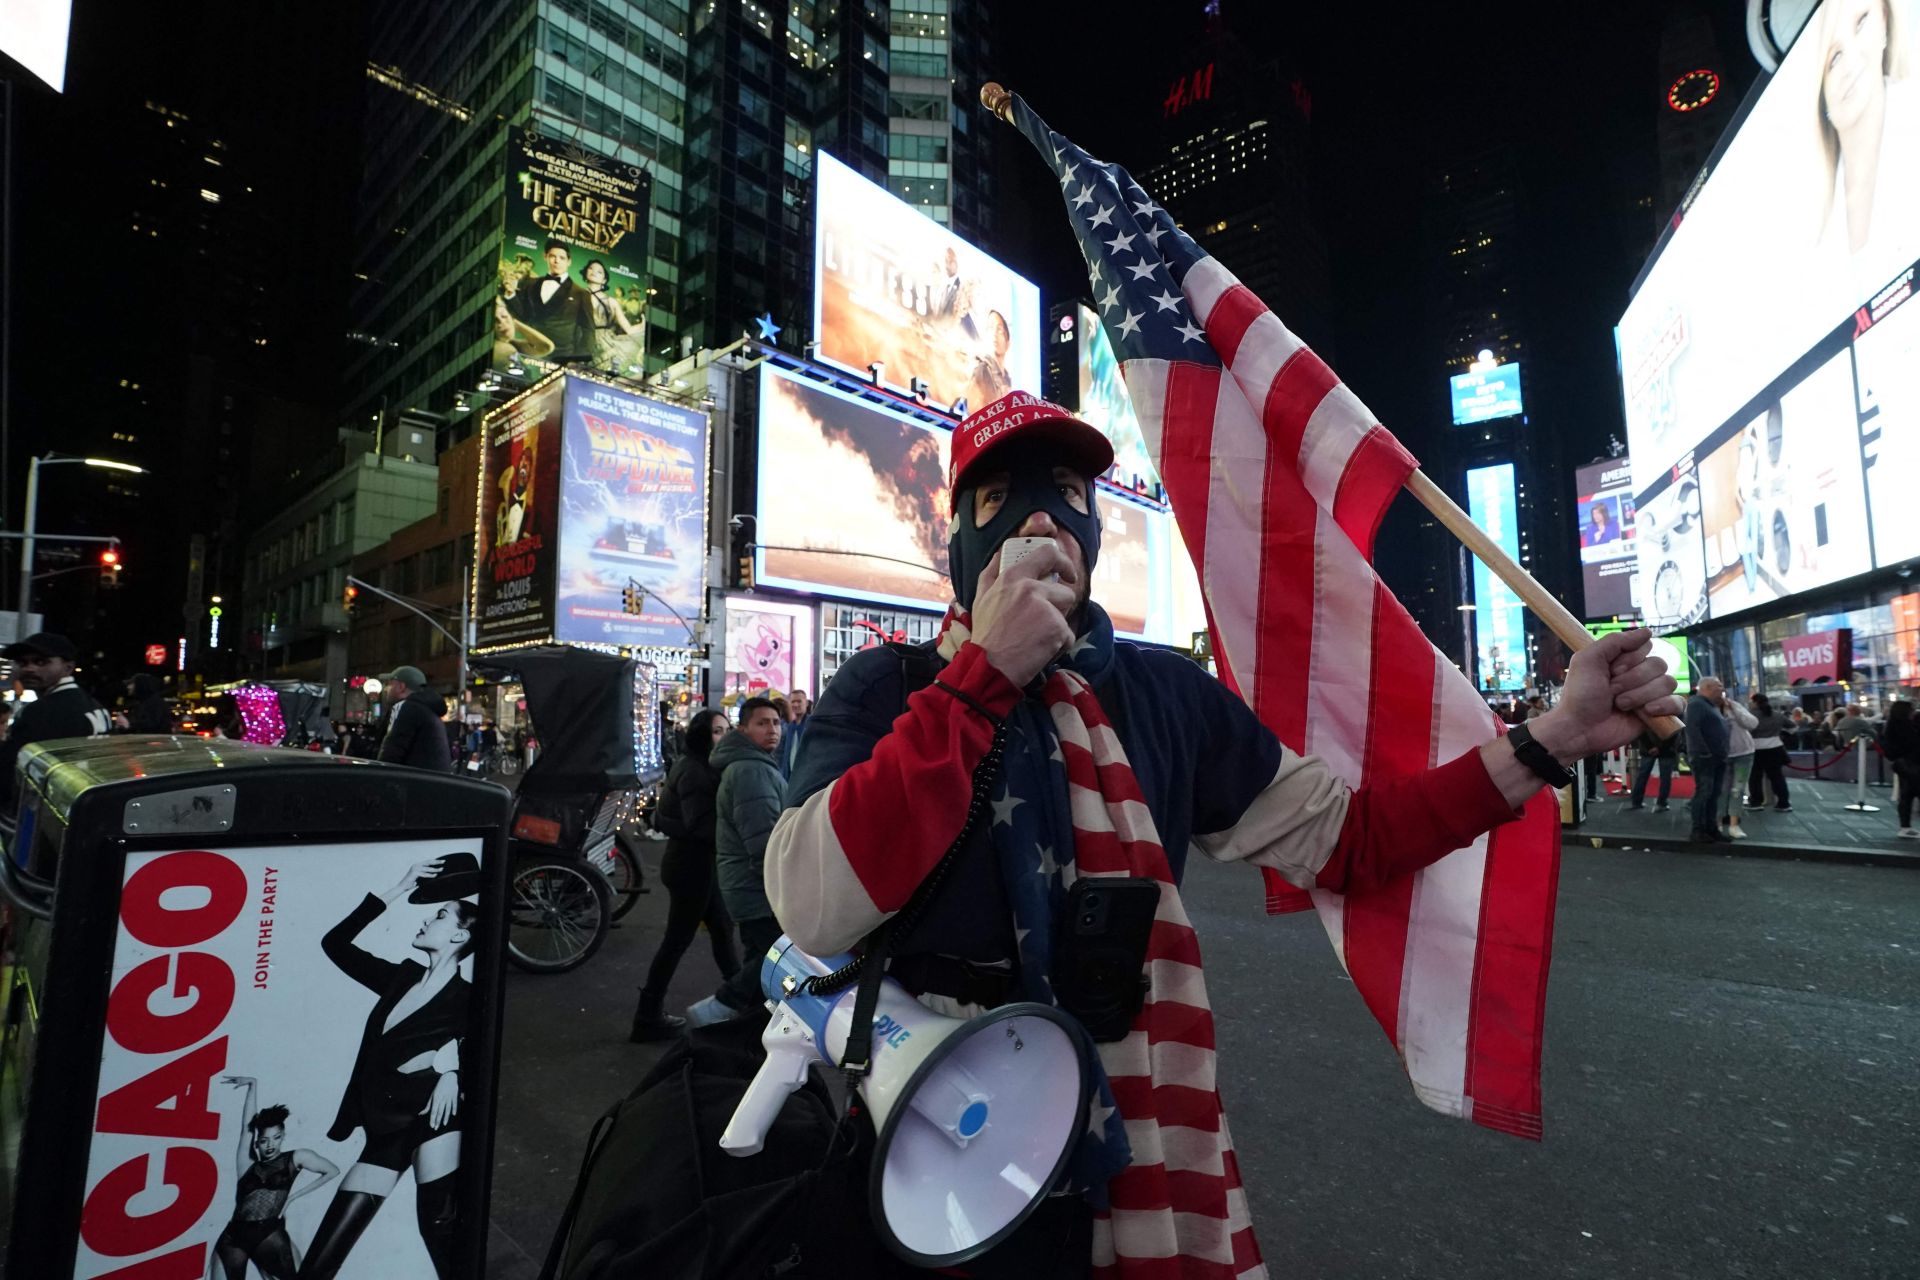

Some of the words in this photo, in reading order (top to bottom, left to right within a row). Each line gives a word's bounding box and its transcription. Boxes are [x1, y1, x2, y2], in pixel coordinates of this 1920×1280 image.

[547, 163, 620, 194] EXTRAVAGANZA
[568, 162, 586, 175] BIG
[587, 168, 638, 192] BROADWAY
[522, 178, 561, 209] THE
[565, 192, 639, 233] GREAT
[532, 205, 626, 249] GATSBY
[555, 233, 574, 245] NEW
[575, 238, 609, 254] MUSICAL
[1060, 331, 1074, 343] LG
[578, 396, 621, 416] MUSICAL
[662, 420, 699, 437] HISTORY
[636, 402, 649, 414] TO
[963, 400, 1006, 433] MAKE
[578, 410, 695, 465] BACK
[973, 412, 1025, 449] GREAT
[592, 450, 617, 468] TO
[615, 456, 695, 483] FUTURE
[494, 553, 537, 582] WORLD
[503, 576, 531, 599] LOUIS
[486, 598, 527, 617] ARMSTRONG
[262, 866, 279, 914] PARTY
[258, 919, 274, 948] THE
[254, 951, 268, 990] JOIN
